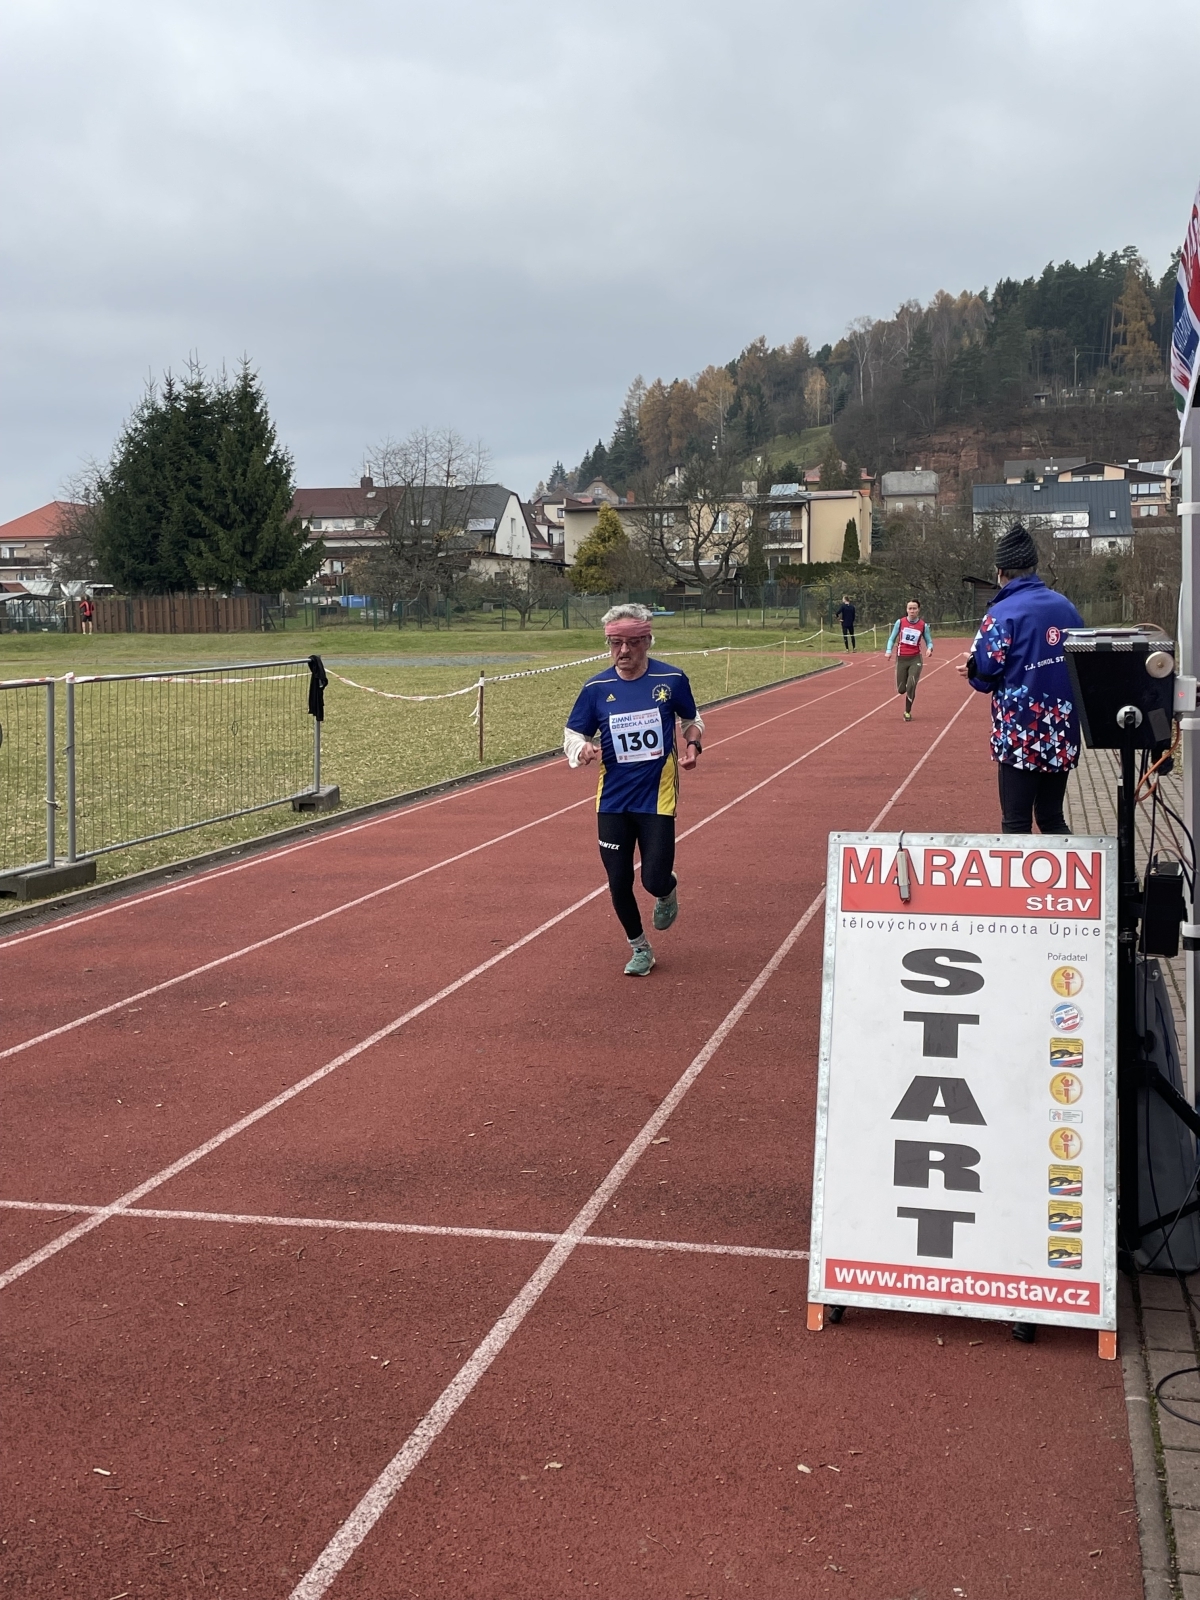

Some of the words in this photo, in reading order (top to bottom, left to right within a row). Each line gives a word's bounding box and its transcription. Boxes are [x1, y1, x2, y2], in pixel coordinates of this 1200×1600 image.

[1024, 663, 1036, 671] T.J.
[1037, 658, 1055, 668] SOKOL
[1055, 655, 1066, 663] ST
[617, 729, 659, 752] 130
[843, 847, 1102, 890] MARATON
[1025, 893, 1093, 912] stav
[842, 917, 960, 933] tělovýchovná
[969, 921, 1038, 935] jednota
[1049, 921, 1101, 938] Úpice
[1047, 952, 1088, 962] Pořadatel
[890, 948, 988, 1259] START
[834, 1266, 1090, 1306] www.maratonstav.cz
